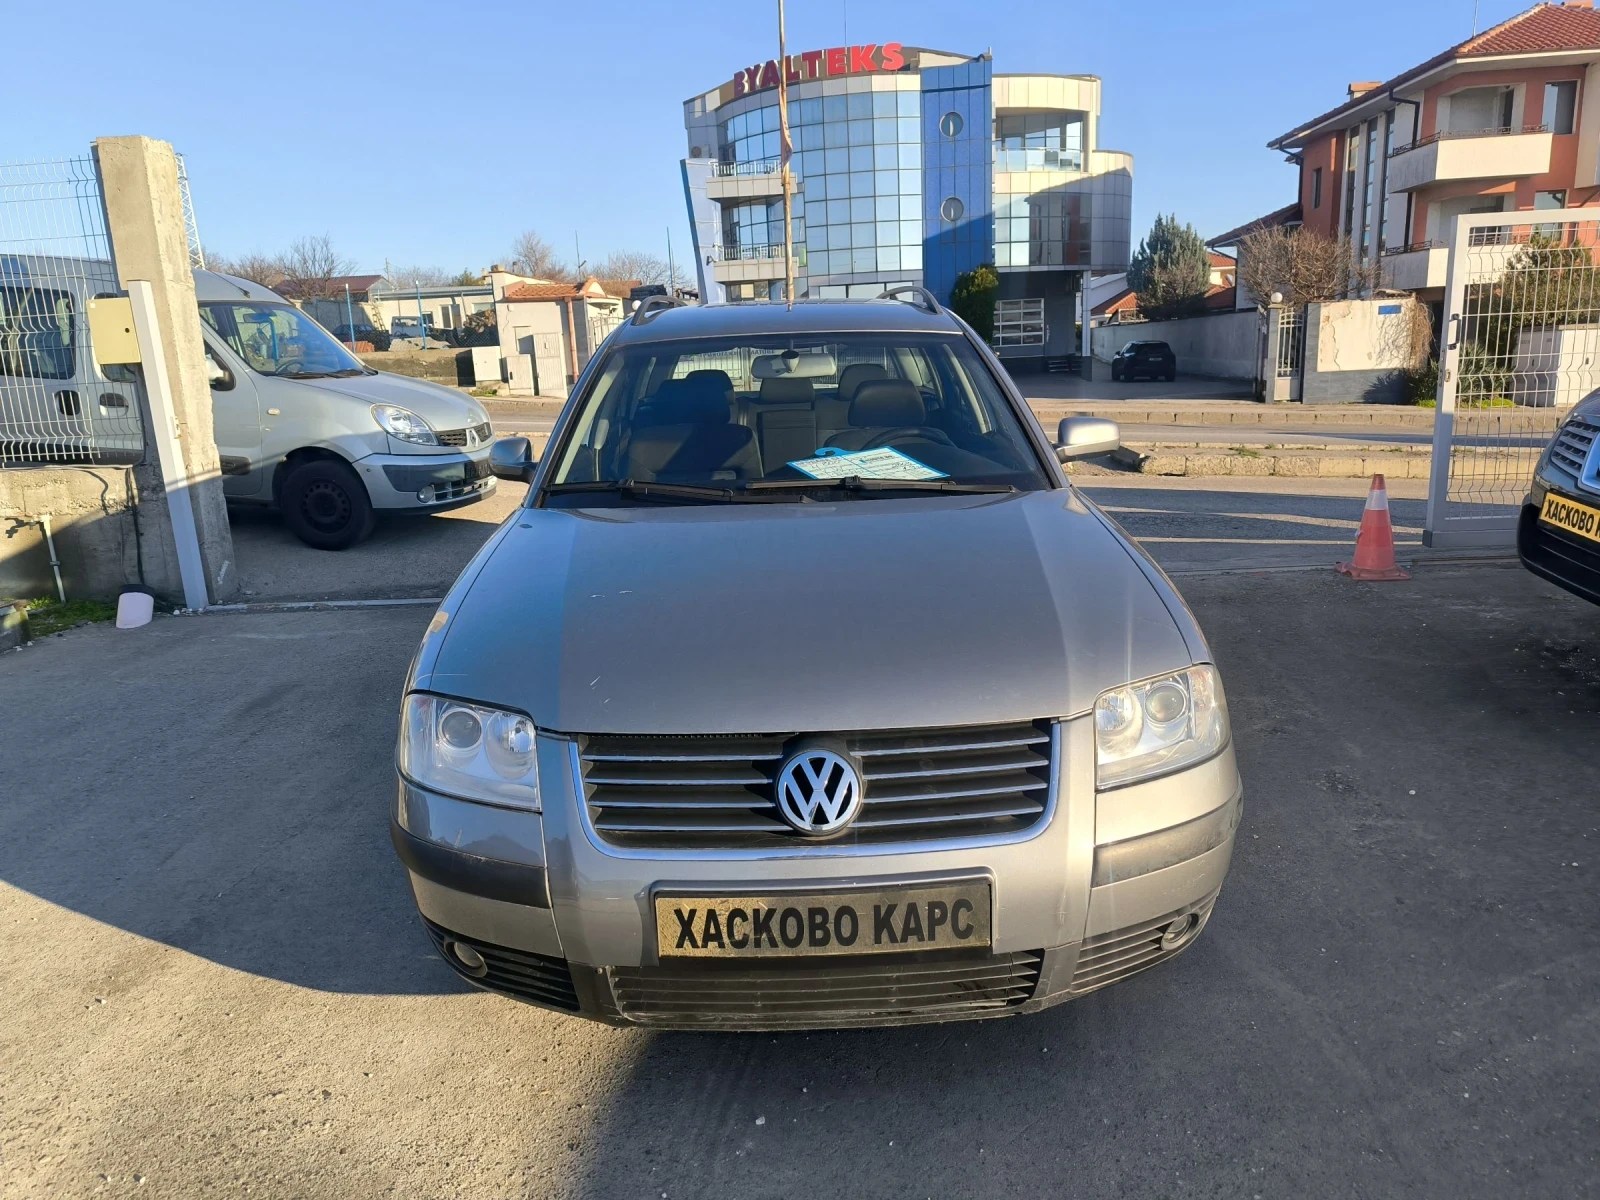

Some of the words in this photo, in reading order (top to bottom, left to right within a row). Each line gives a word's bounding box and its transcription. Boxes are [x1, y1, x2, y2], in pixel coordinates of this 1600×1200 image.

[733, 42, 905, 99] BYALTEKS
[1544, 499, 1595, 534] ХАСКОВО
[673, 905, 859, 949] ХАСКОВО
[873, 898, 975, 945] КАРС
